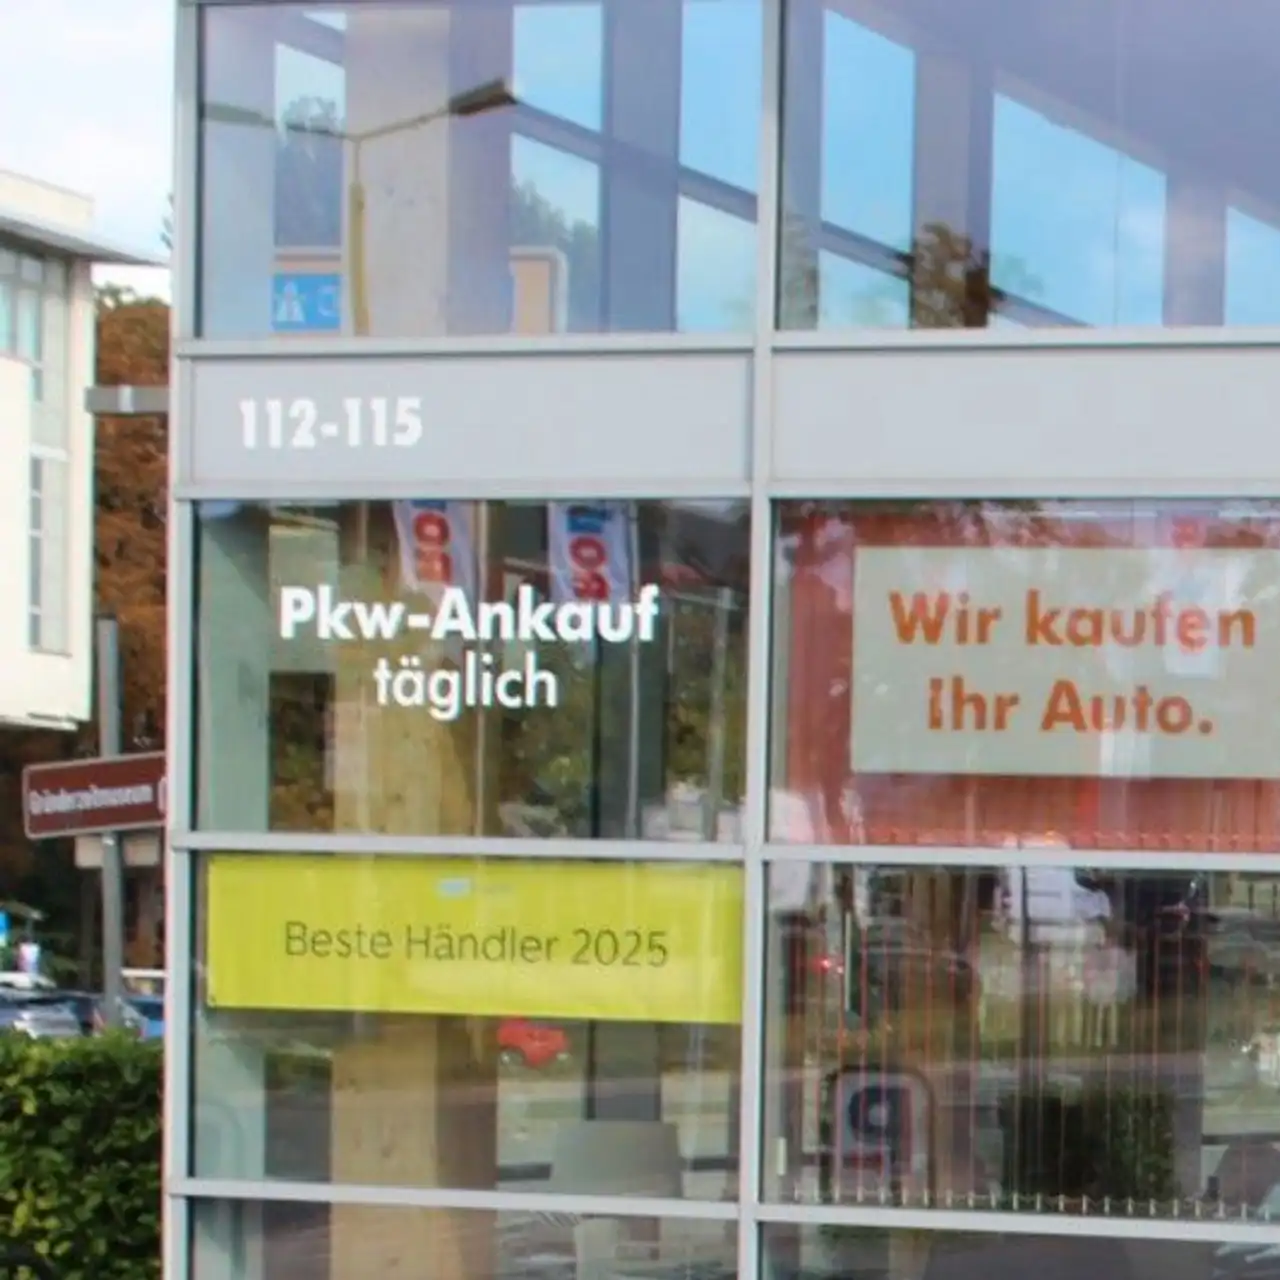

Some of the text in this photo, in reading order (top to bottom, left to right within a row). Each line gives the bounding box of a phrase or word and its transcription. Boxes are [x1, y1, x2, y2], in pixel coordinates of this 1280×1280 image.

[238, 397, 423, 449] 112-115
[280, 583, 660, 641] Pkw-Ankauf
[889, 588, 1254, 648] Wir kaufen
[372, 650, 559, 721] täglich
[928, 676, 1213, 735] Ihr Auto.
[285, 920, 669, 968] Beste Händler 2025
